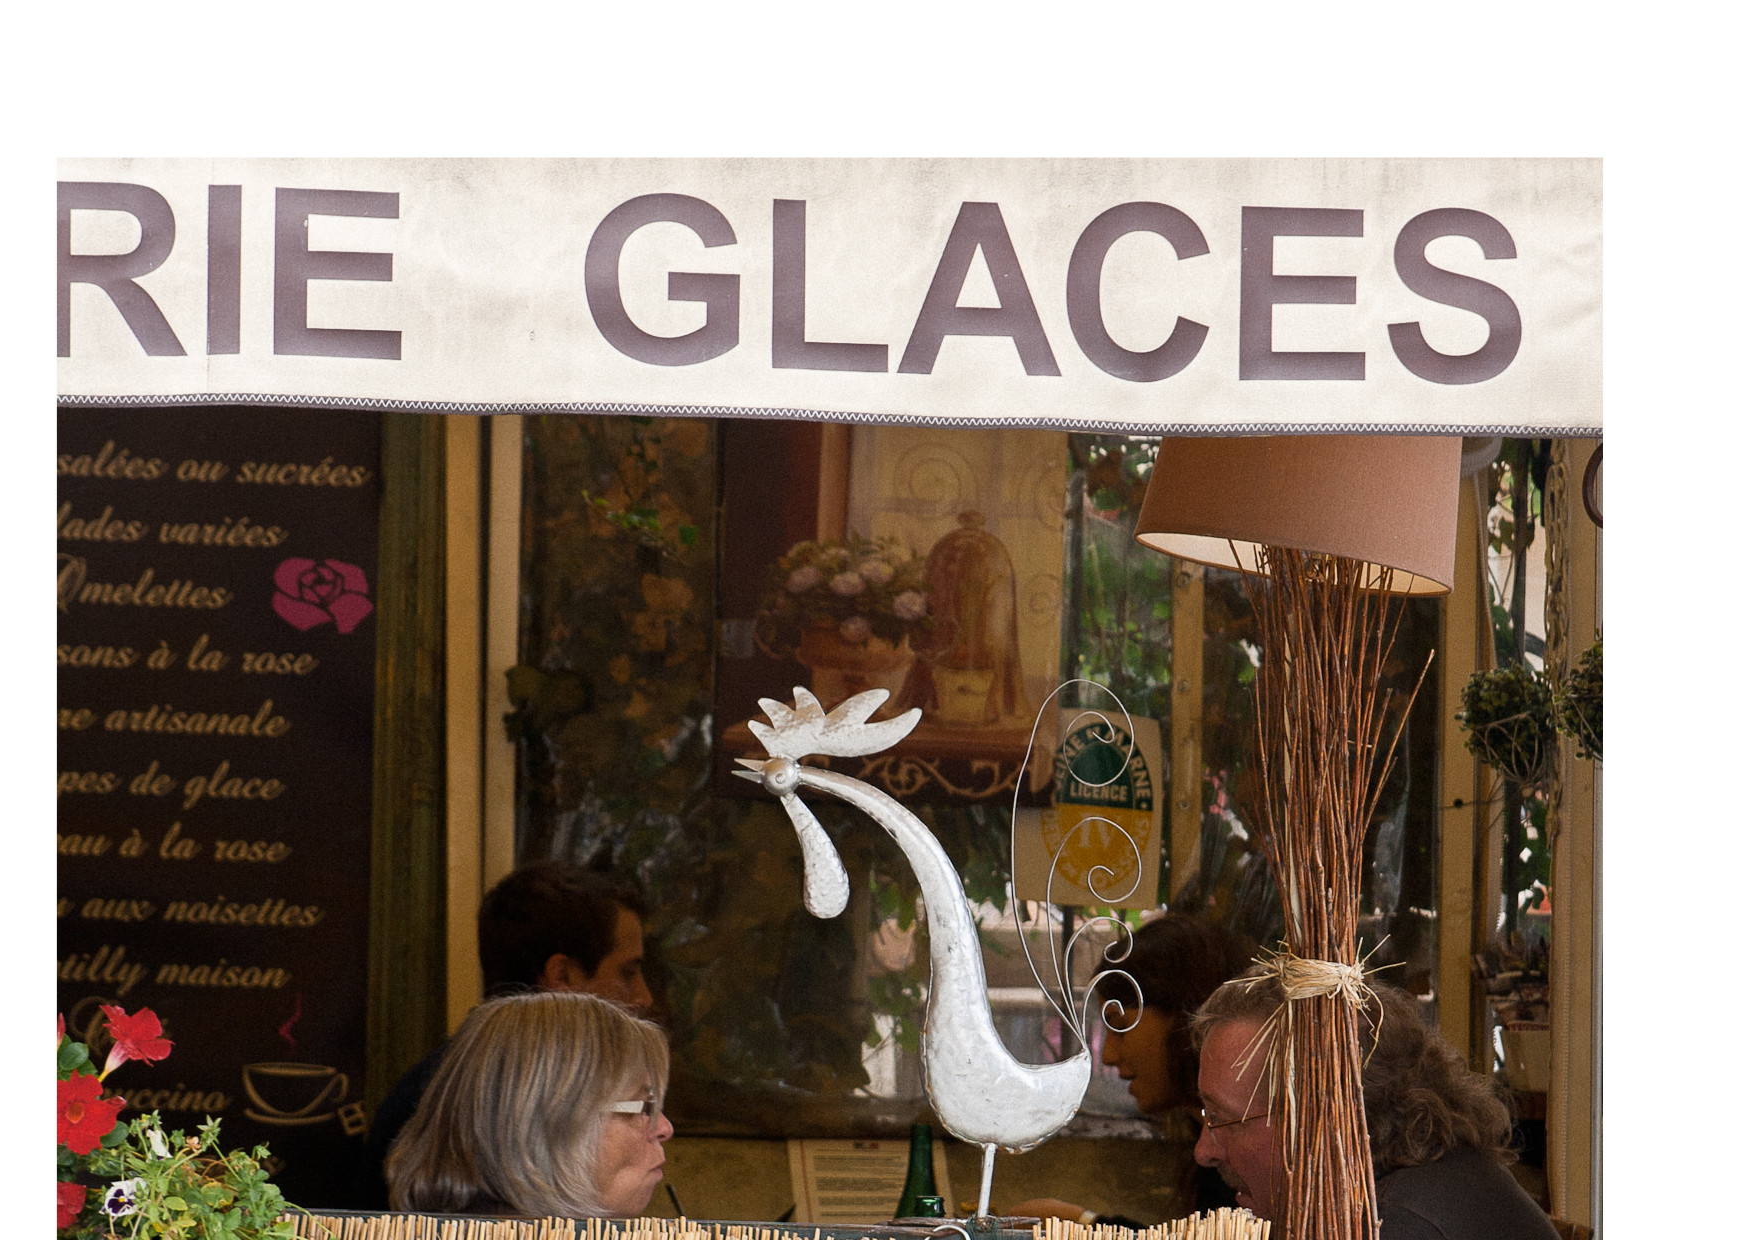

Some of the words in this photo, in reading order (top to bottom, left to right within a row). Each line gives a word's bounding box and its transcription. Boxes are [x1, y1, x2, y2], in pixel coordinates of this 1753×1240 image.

[57, 181, 403, 361] RIE
[584, 192, 1523, 386] GLACES
[176, 459, 230, 482] ou
[236, 456, 372, 488] sucrées
[159, 516, 289, 548] variées
[187, 634, 230, 672] la
[242, 651, 320, 675] rose
[104, 699, 292, 739] artisanale
[128, 758, 176, 797] de
[182, 759, 287, 812] glace
[1069, 783, 1129, 802] LICENCE
[159, 821, 203, 860] la
[213, 838, 293, 863] rose
[81, 897, 154, 922] aux
[162, 895, 326, 928] noisettes
[57, 944, 146, 996] tilly
[155, 957, 294, 989] maison
